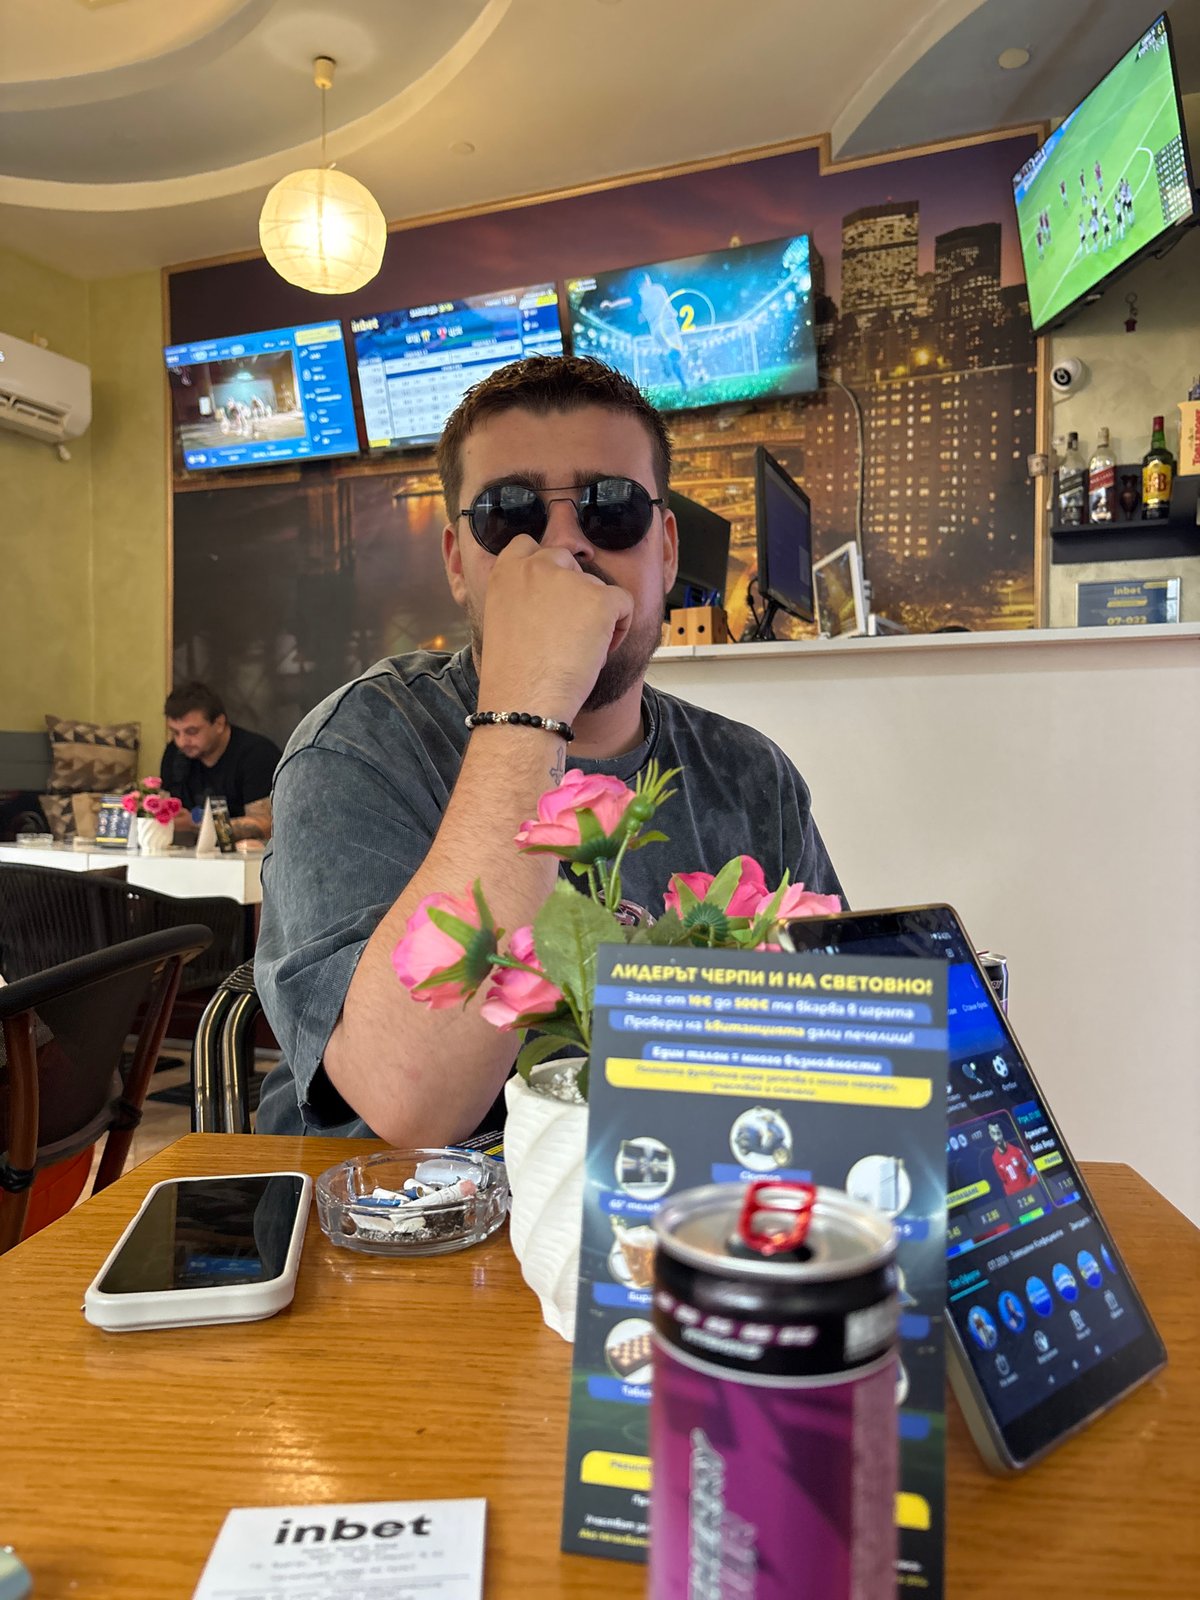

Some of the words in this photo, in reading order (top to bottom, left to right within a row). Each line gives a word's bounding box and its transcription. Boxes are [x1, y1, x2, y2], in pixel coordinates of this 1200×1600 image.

[679, 305, 696, 332] 2
[611, 963, 698, 982] ЛИДЕРЪТ
[701, 967, 766, 986] ЧЕРПИ
[768, 970, 784, 987] И
[787, 972, 816, 989] НА
[819, 973, 933, 996] СВЕТОВНО!
[625, 991, 663, 1005] Залог
[664, 995, 687, 1006] от
[714, 998, 732, 1011] до
[771, 1001, 794, 1011] те
[795, 1000, 845, 1016] вкарва
[847, 1001, 856, 1016] в
[858, 1006, 915, 1021] играта
[624, 1014, 683, 1031] Провери
[685, 1019, 702, 1030] на
[807, 1027, 842, 1041] дали
[783, 1054, 882, 1073] възможности
[274, 1513, 432, 1545] inbet
